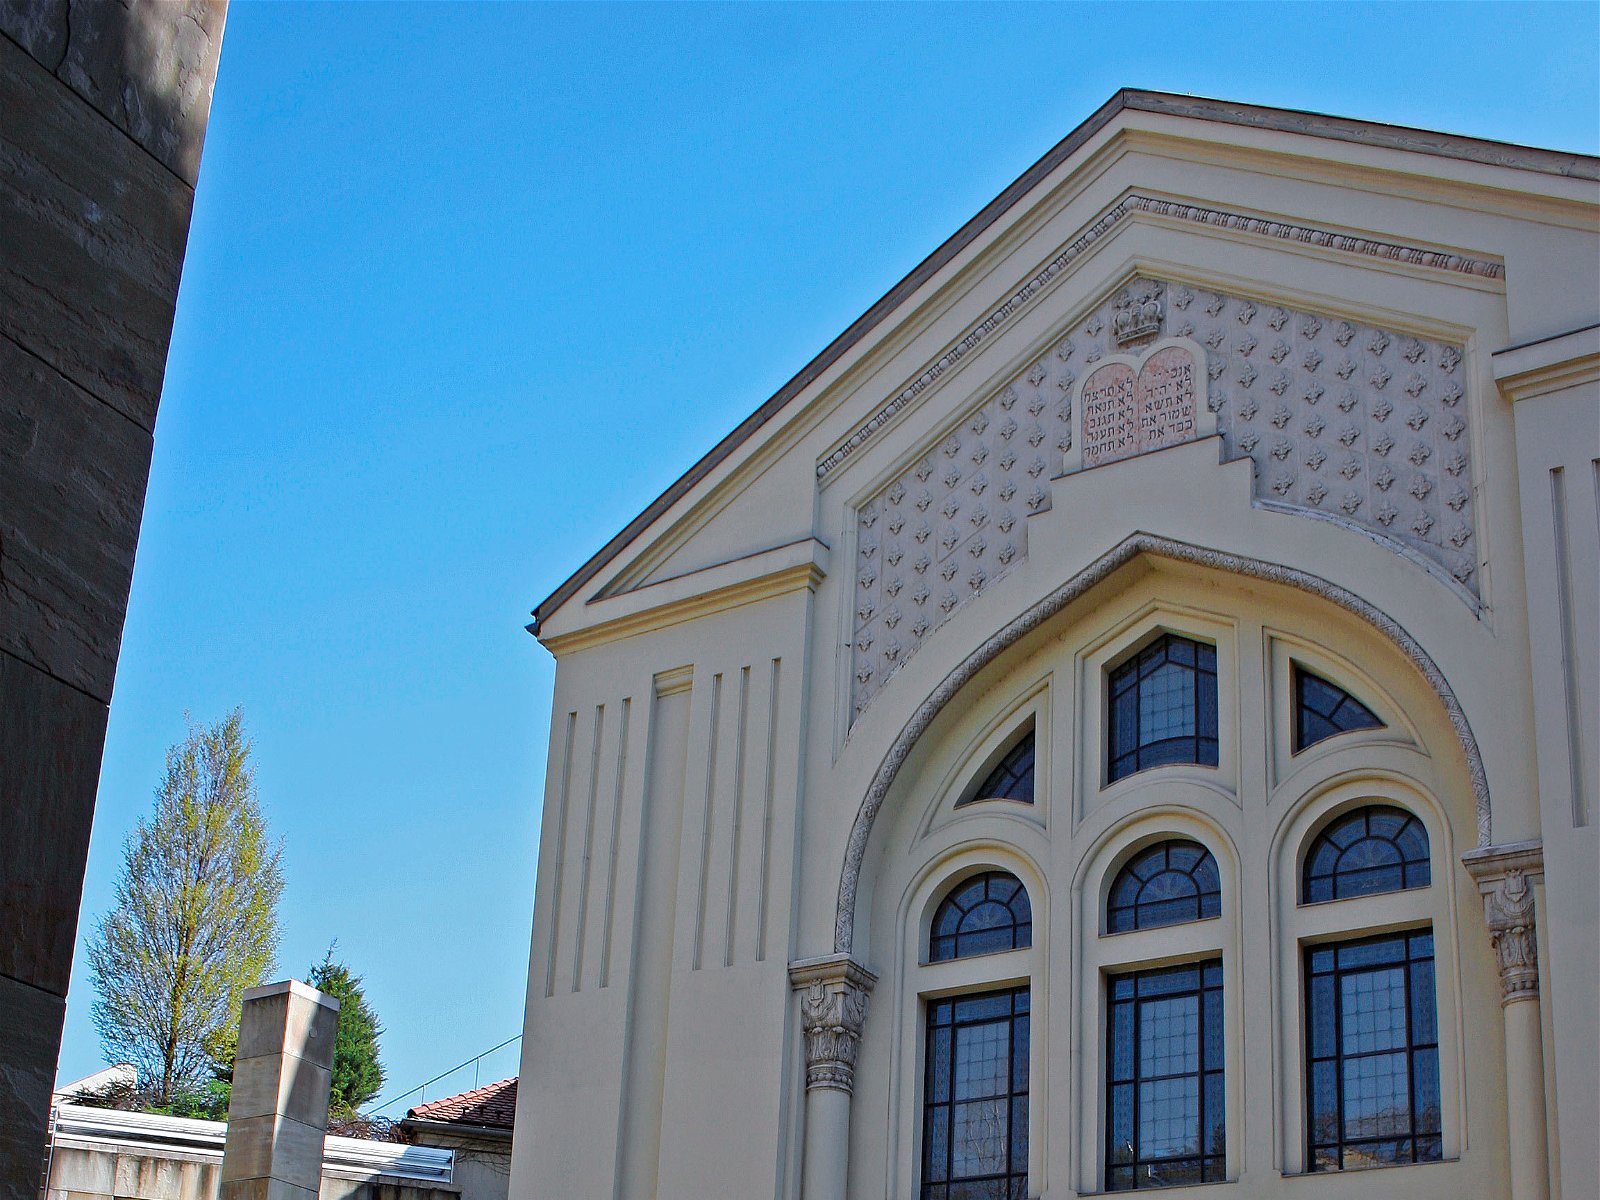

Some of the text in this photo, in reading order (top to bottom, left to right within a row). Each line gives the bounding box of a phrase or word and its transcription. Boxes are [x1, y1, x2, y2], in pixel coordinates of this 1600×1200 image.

[1166, 364, 1191, 378] אנכי
[1084, 377, 1132, 403] לא תרצח
[1145, 375, 1191, 400] לא יהיה
[1087, 391, 1133, 415] לא תנאף
[1145, 389, 1191, 413] לא תשא
[1090, 405, 1133, 429] לא תגנב
[1142, 406, 1191, 428] שמור את
[1087, 419, 1133, 443] לא תענה
[1149, 420, 1192, 440] כבד את
[1084, 433, 1133, 458] לא תחמד
